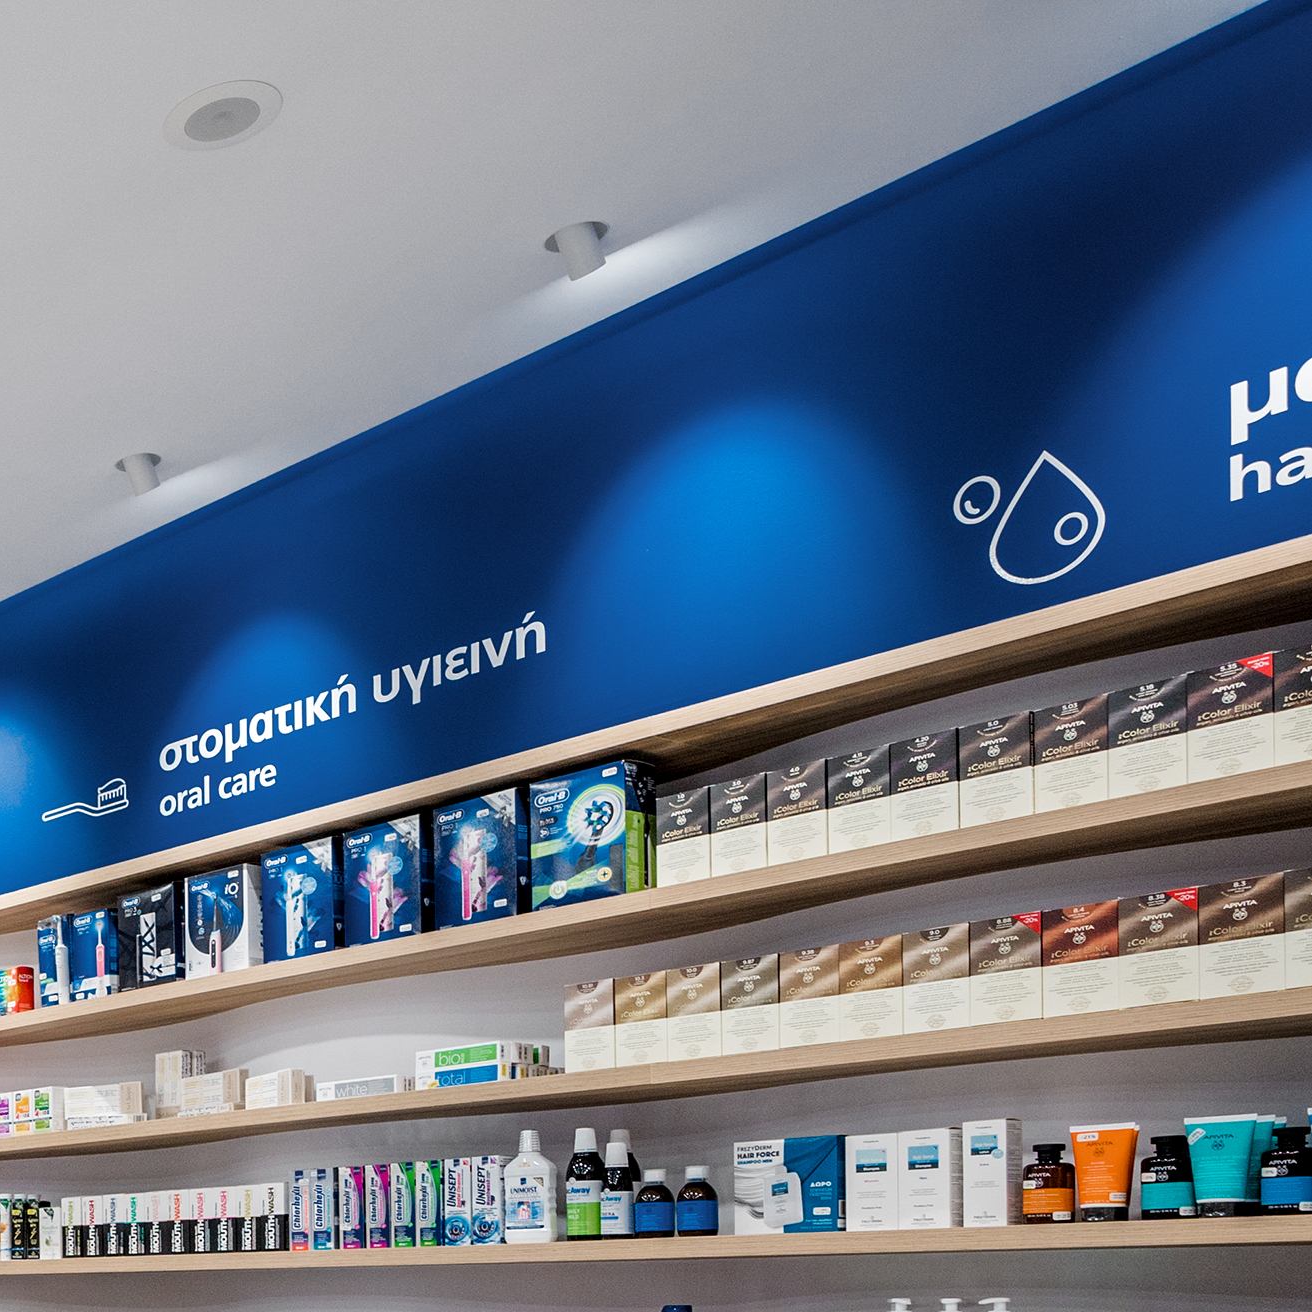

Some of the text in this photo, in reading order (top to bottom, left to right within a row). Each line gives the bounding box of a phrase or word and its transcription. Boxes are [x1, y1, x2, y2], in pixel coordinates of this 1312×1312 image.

[159, 612, 547, 772] στοματική υγιεινή
[1212, 682, 1246, 694] APIVITA
[159, 766, 278, 818] oral care
[537, 791, 567, 804] Oral-B
[439, 811, 462, 822] Oral-B
[348, 836, 370, 846] Oral-B
[266, 856, 286, 866] Oral-B
[1224, 900, 1257, 909] APIVITA
[737, 1150, 780, 1160] HAIR FORCE
[447, 1168, 457, 1207] UNISEPT
[476, 1166, 486, 1205] UNISEPT
[510, 1187, 537, 1195] UNIMOIST
